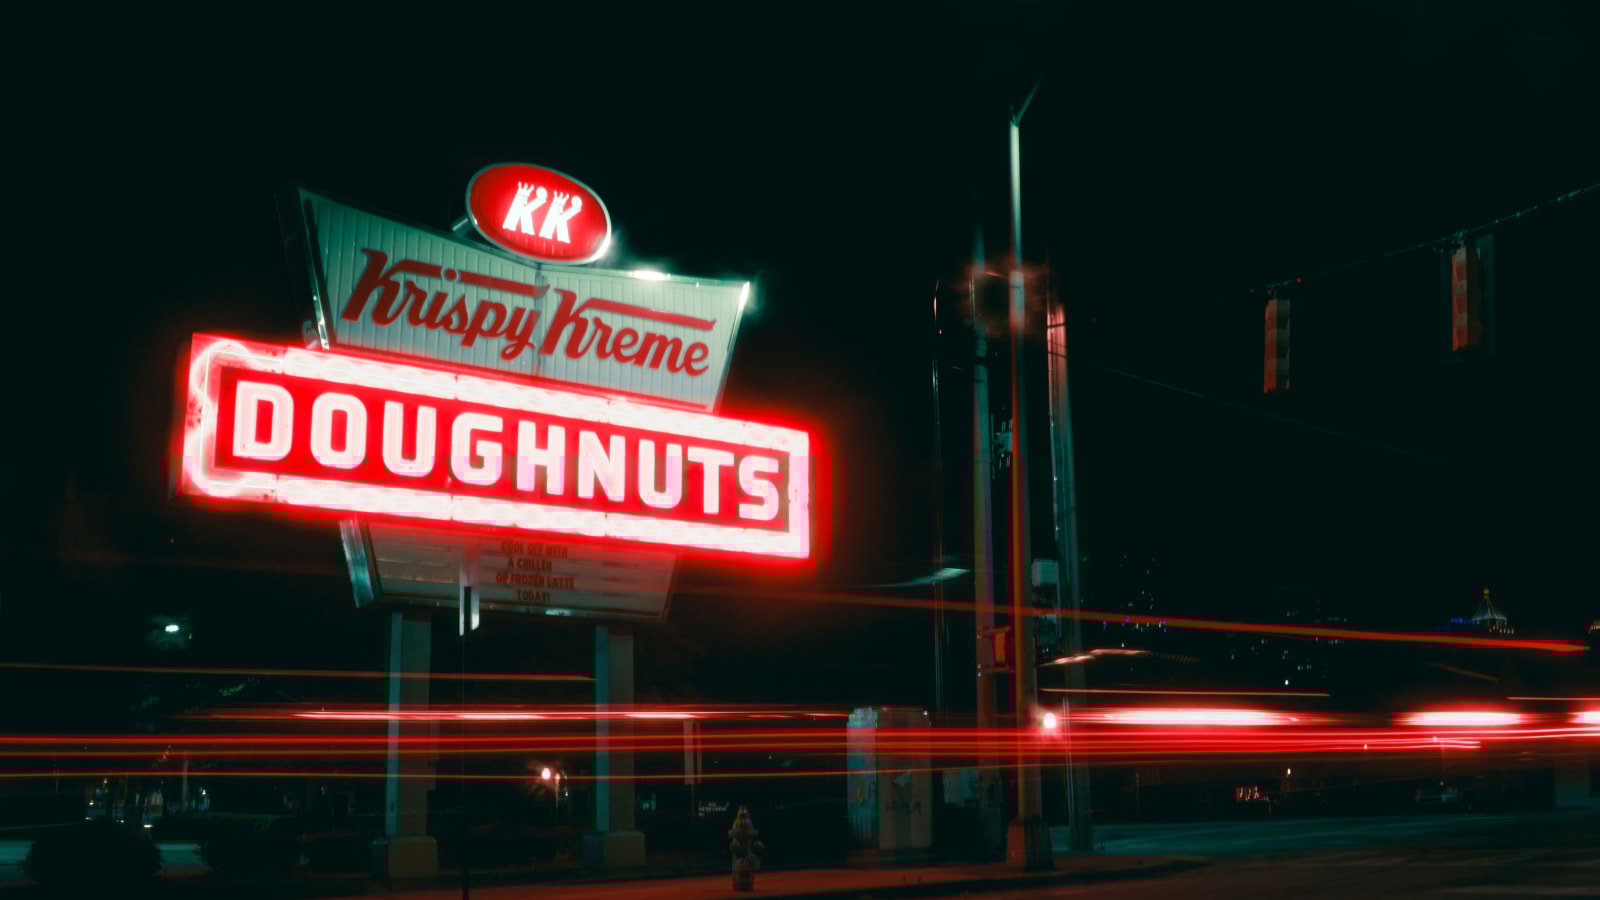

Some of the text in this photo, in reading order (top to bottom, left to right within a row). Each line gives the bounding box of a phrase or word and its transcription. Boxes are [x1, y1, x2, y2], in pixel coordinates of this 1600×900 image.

[502, 181, 582, 244] KK
[340, 248, 716, 377] Krispy Kreme
[232, 381, 781, 521] DOUGHNUTS
[496, 572, 575, 589] OR FROZEN LATTE
[507, 557, 552, 571] A CHILLER
[517, 591, 550, 602] TODAY!
